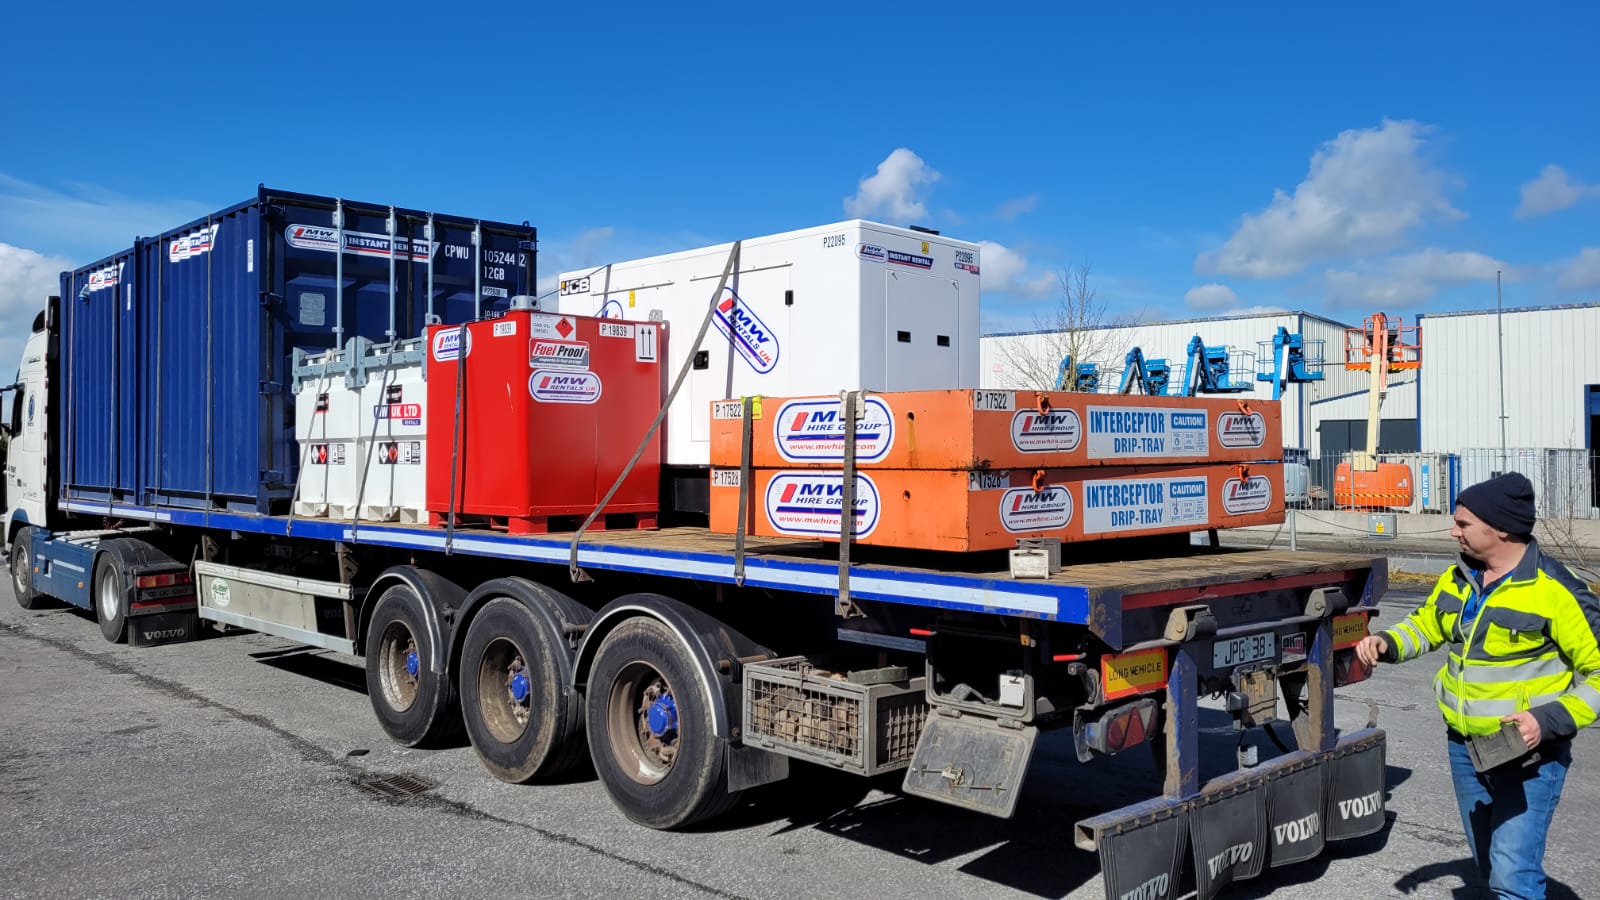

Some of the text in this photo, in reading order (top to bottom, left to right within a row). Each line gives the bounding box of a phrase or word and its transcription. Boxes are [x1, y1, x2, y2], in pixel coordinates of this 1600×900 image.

[348, 237, 389, 249] INSTANT
[823, 234, 846, 248] P22095
[445, 244, 469, 260] CPWU
[484, 249, 515, 265] 105244
[889, 252, 911, 262] INSTANT
[912, 257, 931, 266] RENTAL
[955, 250, 974, 264] P22095
[484, 266, 505, 280] 12GB
[561, 279, 590, 296] JCB
[601, 326, 628, 337] P 19839
[727, 314, 760, 350] RENTALS
[734, 308, 770, 343] MW
[534, 343, 585, 358] Fuel Proof
[759, 350, 772, 363] UK
[552, 376, 588, 385] MW
[977, 392, 1007, 409] P 17522
[391, 405, 402, 417] UK
[403, 405, 418, 417] LTD
[715, 404, 742, 418] P 17522
[1034, 415, 1067, 424] MW
[1090, 410, 1165, 433] INTERCEPTOR
[1173, 416, 1203, 427] CAUTION!
[1233, 417, 1255, 425] MW
[806, 423, 882, 432] HIRE GOUP
[789, 442, 876, 451] www.mwhircom
[1114, 437, 1165, 453] DRIP-TRAY
[714, 471, 739, 486] P 17528
[970, 472, 975, 489] P
[799, 483, 856, 496] MW
[1171, 484, 1203, 495] CAUTION!
[1238, 481, 1261, 491] MW
[826, 498, 869, 506] GRUP
[1024, 492, 1058, 503] MW
[1087, 483, 1164, 508] INTERCEPTOR
[779, 515, 864, 527] www.mwhire.m
[1111, 508, 1164, 527] DRIP-TRAY
[144, 628, 185, 640] VOLVO
[1343, 622, 1364, 634] VEHICLE
[1225, 636, 1266, 664] JPG 38
[1108, 662, 1161, 681] LONG VEHICLE
[1338, 790, 1382, 820] VOLVO
[1273, 812, 1319, 846] VOLVO
[1208, 841, 1253, 880] VOLVO
